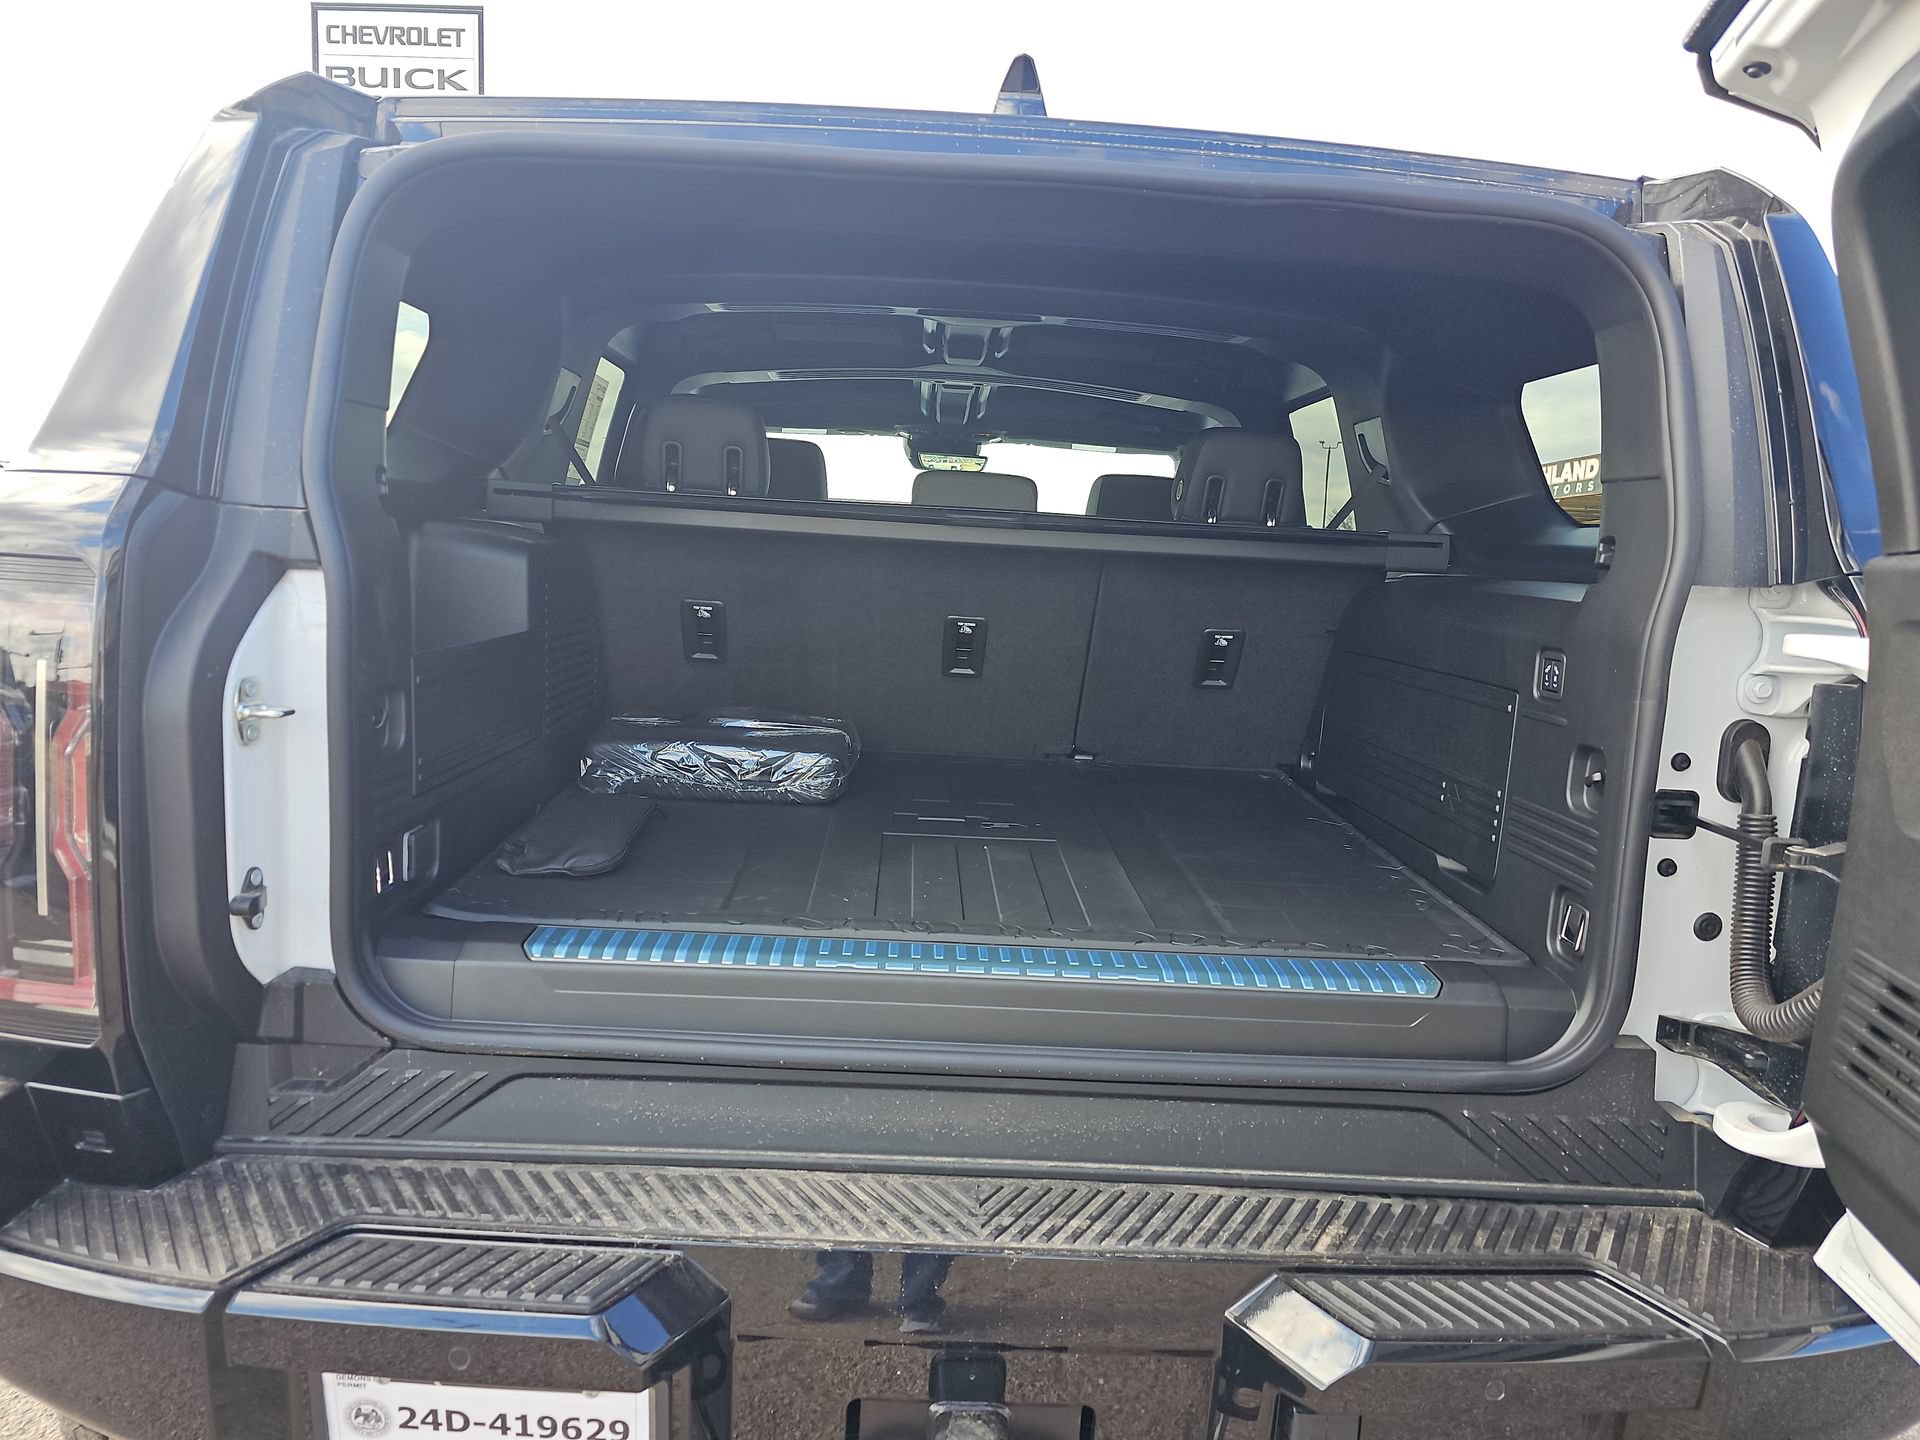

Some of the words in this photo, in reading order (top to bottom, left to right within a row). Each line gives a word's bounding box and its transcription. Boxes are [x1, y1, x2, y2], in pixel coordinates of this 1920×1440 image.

[326, 24, 466, 48] CHEVROLET
[325, 66, 469, 91] BUICK
[1553, 480, 1594, 495] TORS
[397, 1406, 630, 1440] 24D-419629
